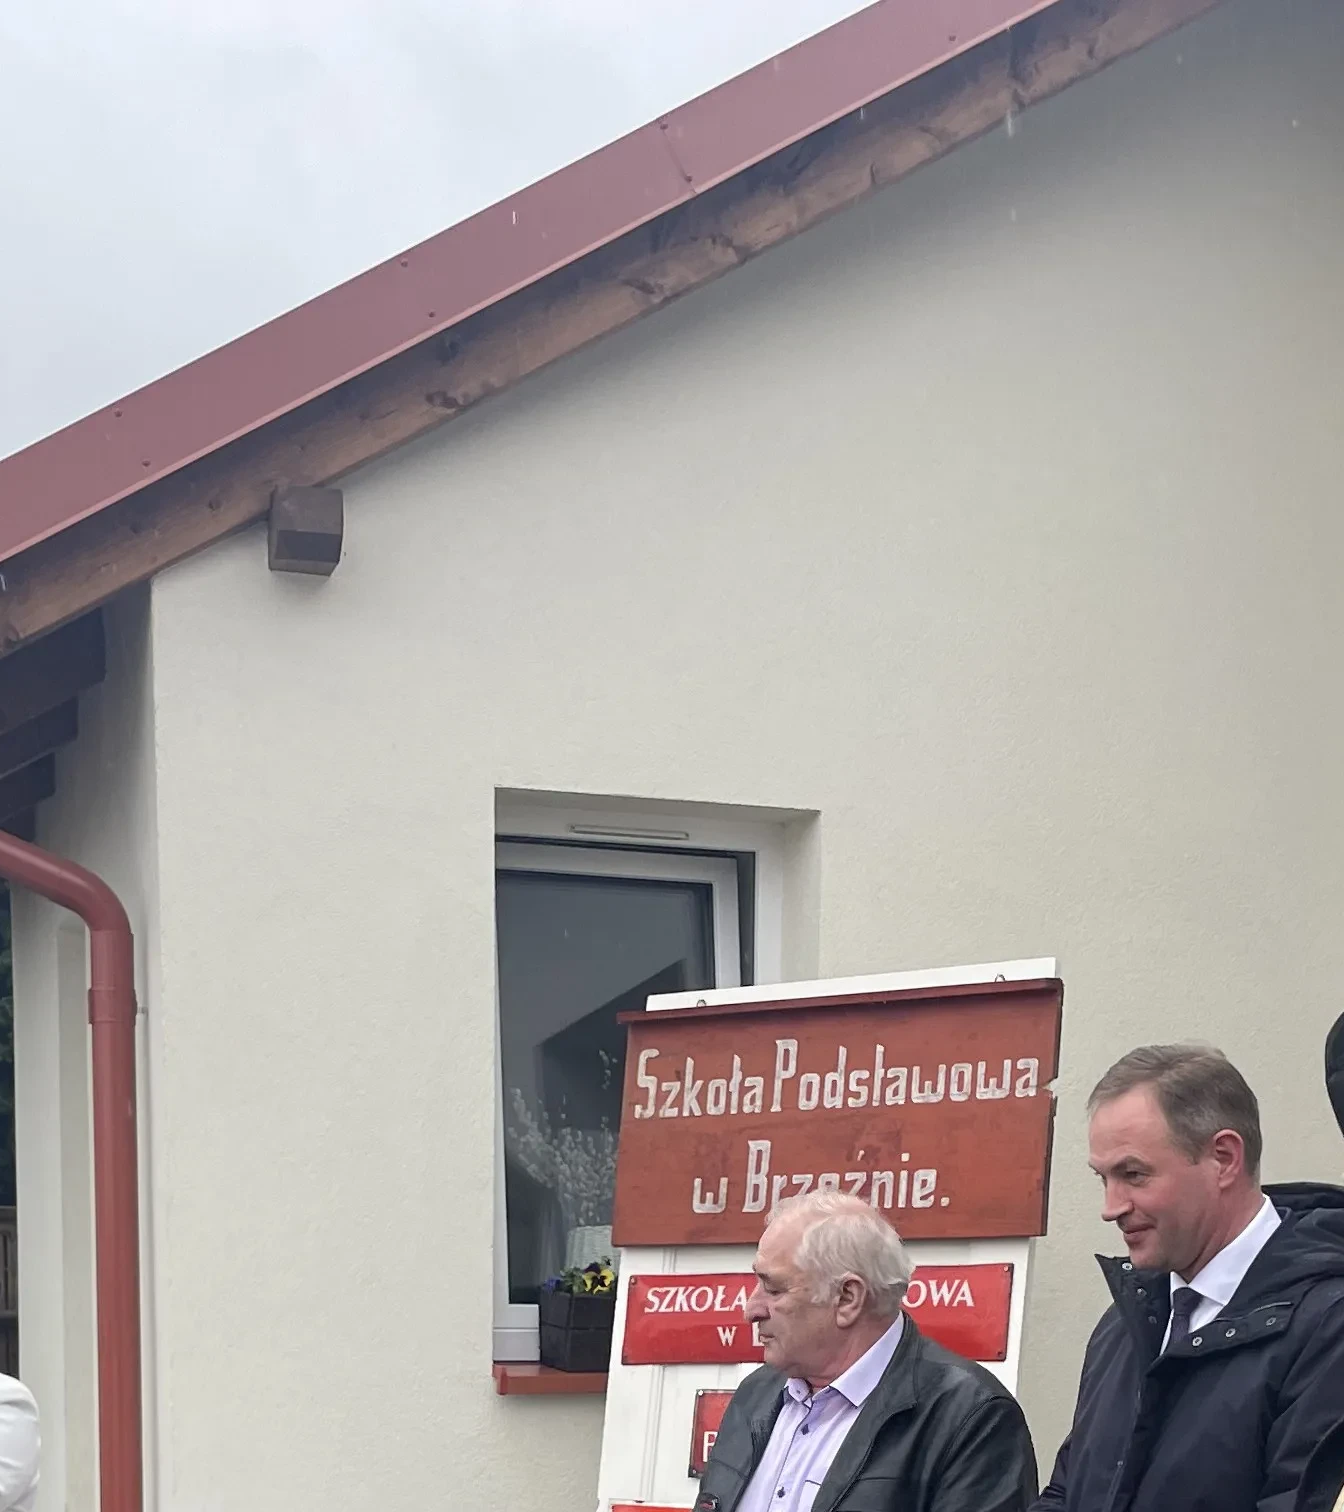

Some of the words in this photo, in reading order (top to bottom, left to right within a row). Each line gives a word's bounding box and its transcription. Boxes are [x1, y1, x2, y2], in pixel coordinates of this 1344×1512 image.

[634, 1048, 764, 1119] Szkoła
[770, 1038, 1039, 1113] Podsławowa
[692, 1176, 728, 1214] w
[644, 1284, 748, 1313] SZKOŁA
[717, 1325, 737, 1347] W
